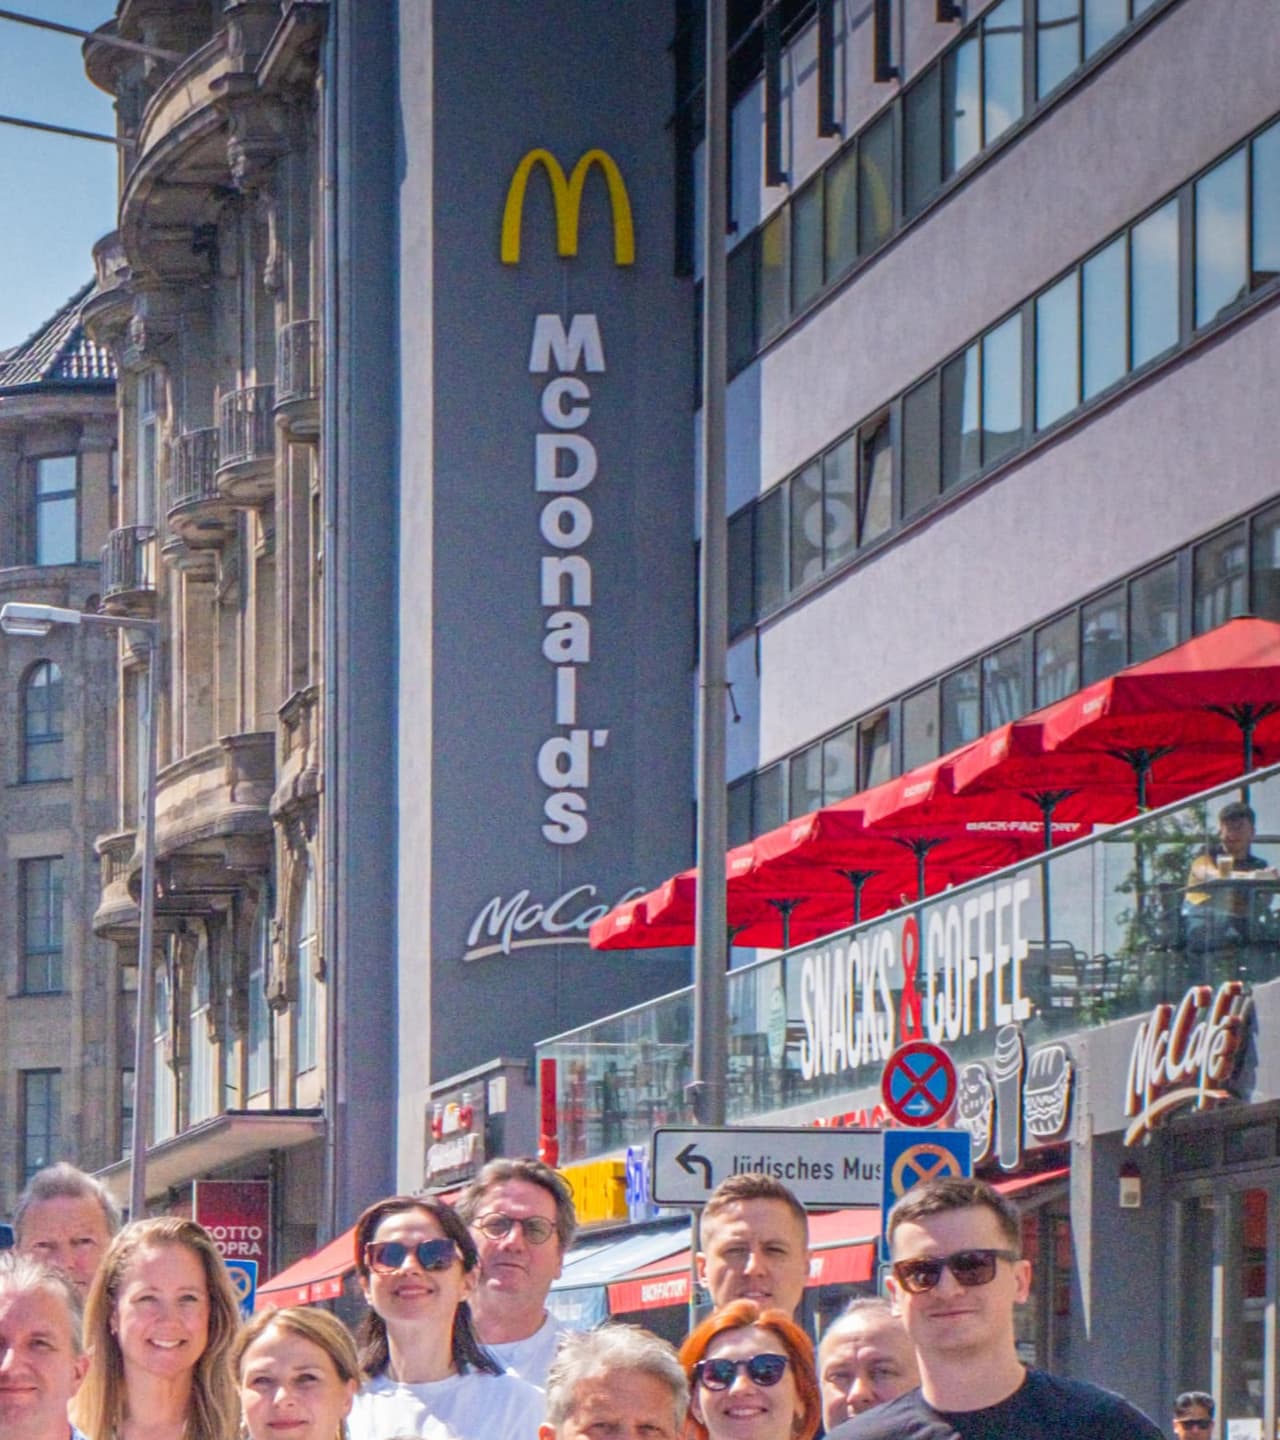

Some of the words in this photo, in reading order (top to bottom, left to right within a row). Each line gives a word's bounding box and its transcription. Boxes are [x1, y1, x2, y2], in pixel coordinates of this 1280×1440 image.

[529, 313, 609, 846] McDonald's
[468, 885, 646, 954] McCa
[801, 930, 895, 1080] SNACKS
[901, 915, 923, 1043] &
[928, 879, 1032, 1043] COFFEE
[728, 1155, 833, 1180] Jüdisches
[215, 1241, 262, 1256] OPRA
